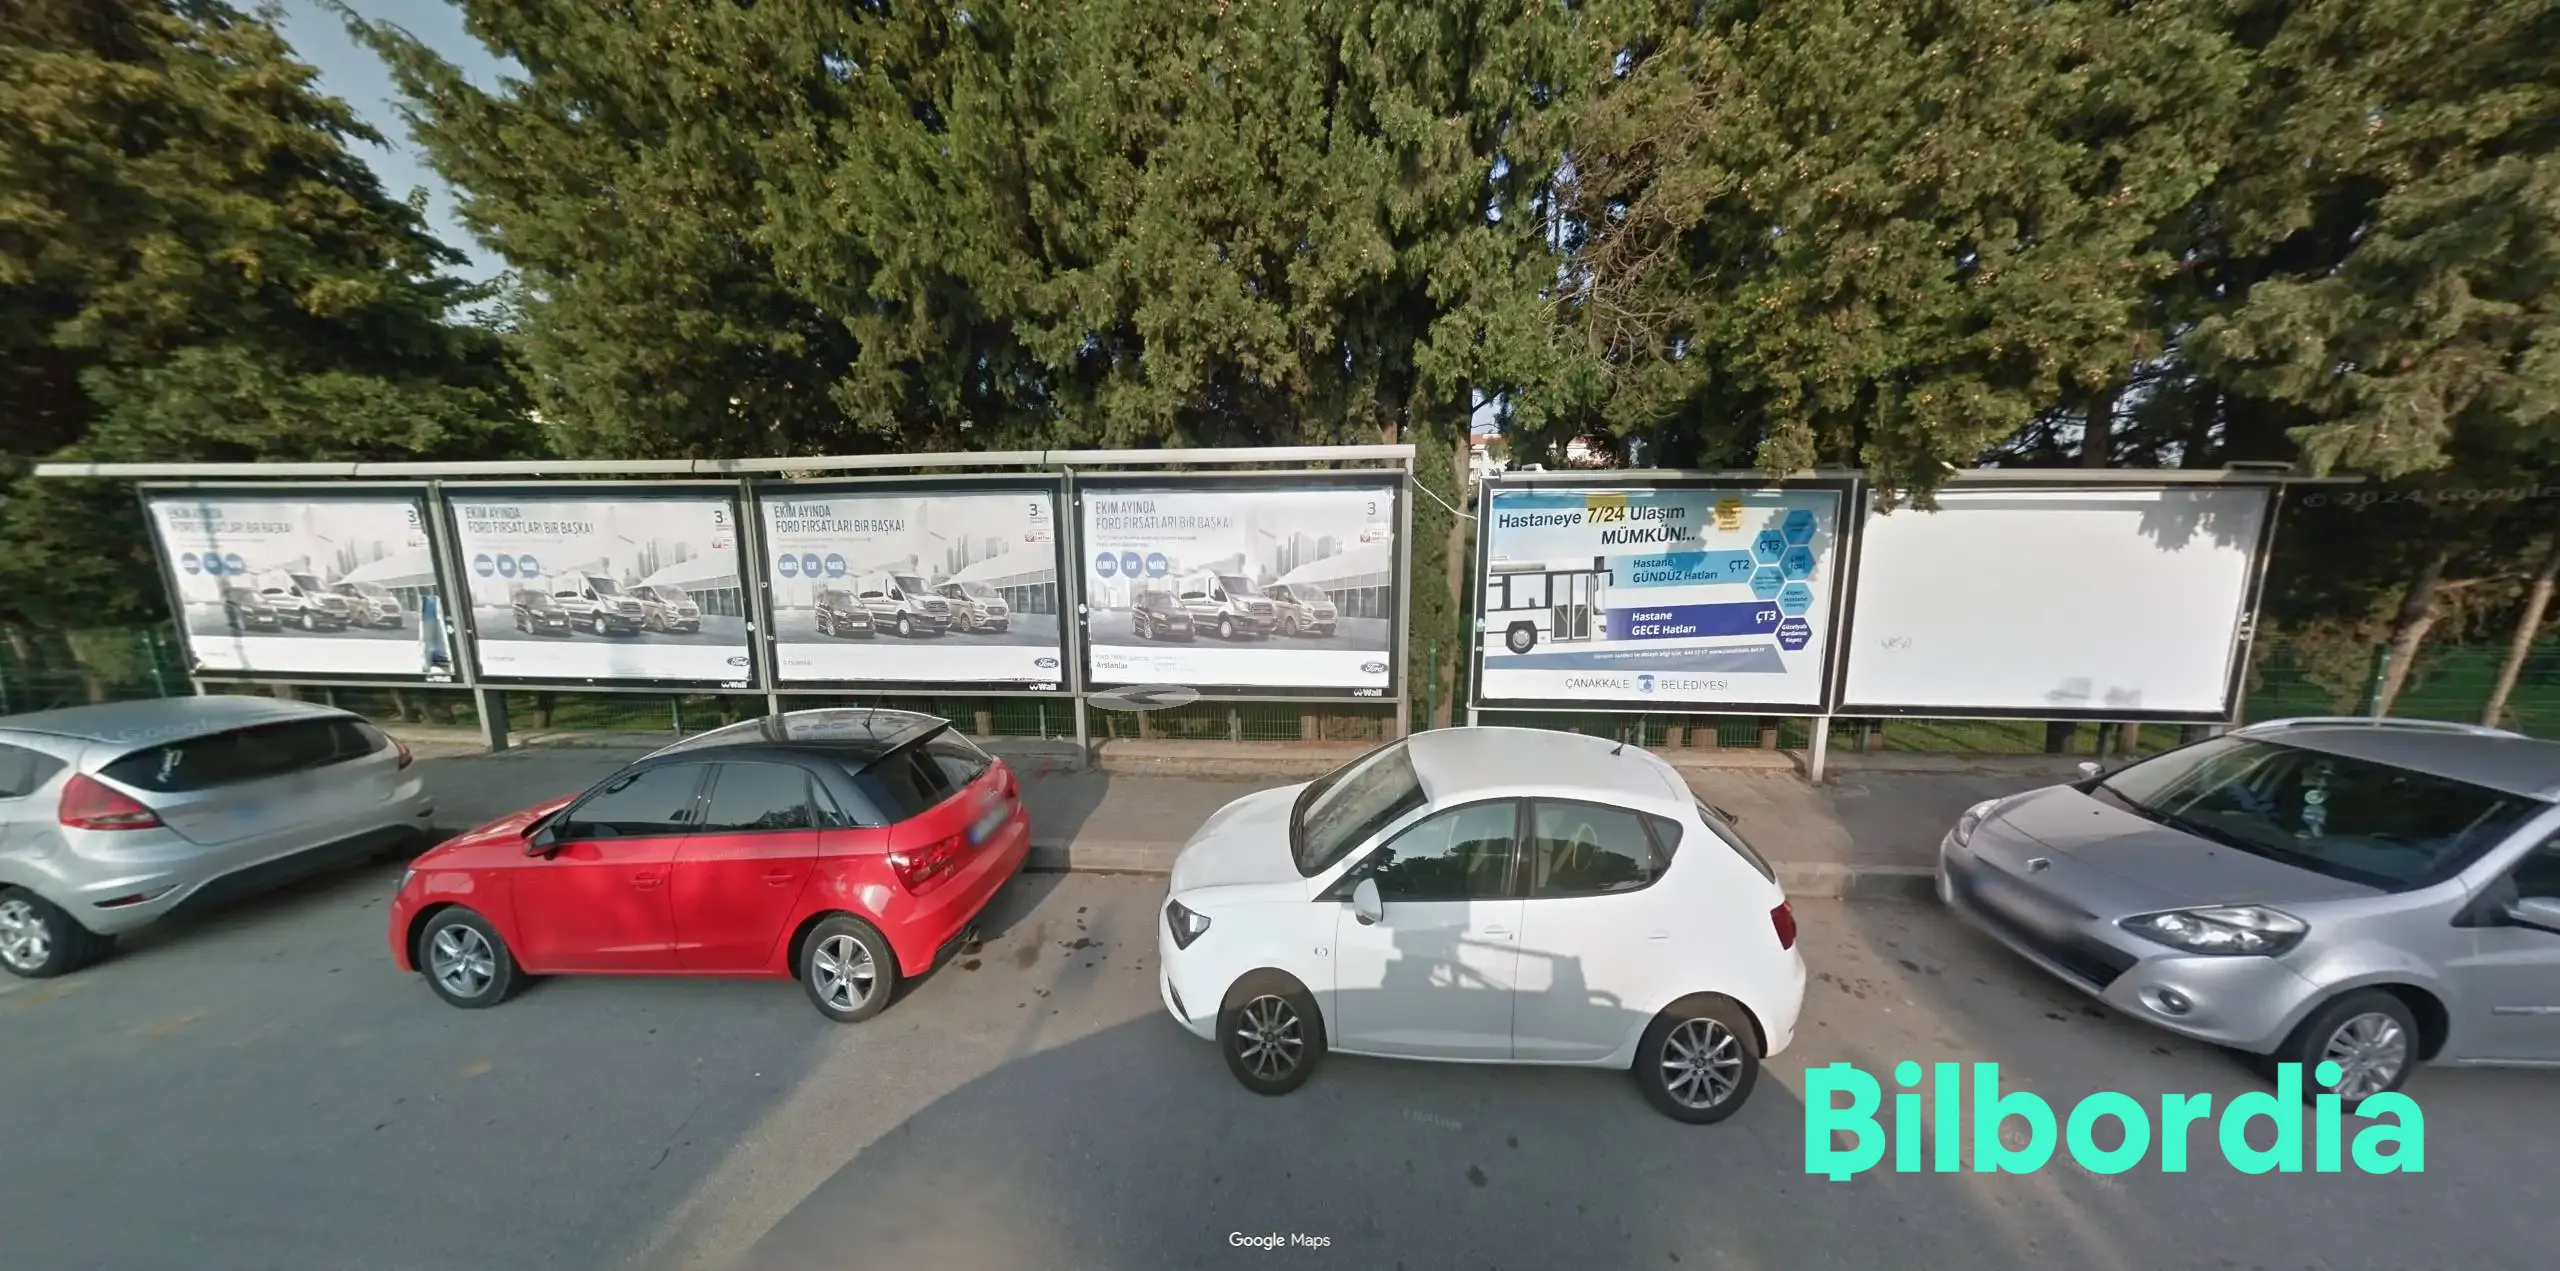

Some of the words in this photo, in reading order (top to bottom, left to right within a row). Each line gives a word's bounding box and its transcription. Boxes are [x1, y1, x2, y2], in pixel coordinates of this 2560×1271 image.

[798, 505, 832, 518] AYINDA
[1029, 503, 1038, 517] 3
[1121, 500, 1156, 514] AYINDA
[1367, 501, 1376, 515] 3
[714, 510, 723, 524] 3
[1096, 517, 1121, 530] FORD
[1499, 511, 1582, 529] Hastaneye
[1587, 506, 1625, 523] 7/24
[1630, 505, 1686, 523] Ulaşım
[776, 520, 800, 533] FORD
[802, 519, 853, 533] FIRSATLARI
[1601, 524, 1696, 545] MÜMKÜN!..
[1633, 558, 1674, 569] Hastane
[1729, 559, 1750, 574] ÇT2
[1632, 611, 1673, 622] Hastane
[1756, 609, 1777, 623] ÇT3
[1632, 624, 1660, 636] GECE
[1663, 624, 1696, 635] Hatları
[1564, 678, 1631, 691] ÇANAKKALE
[1660, 678, 1728, 691] BELEDİYESİ
